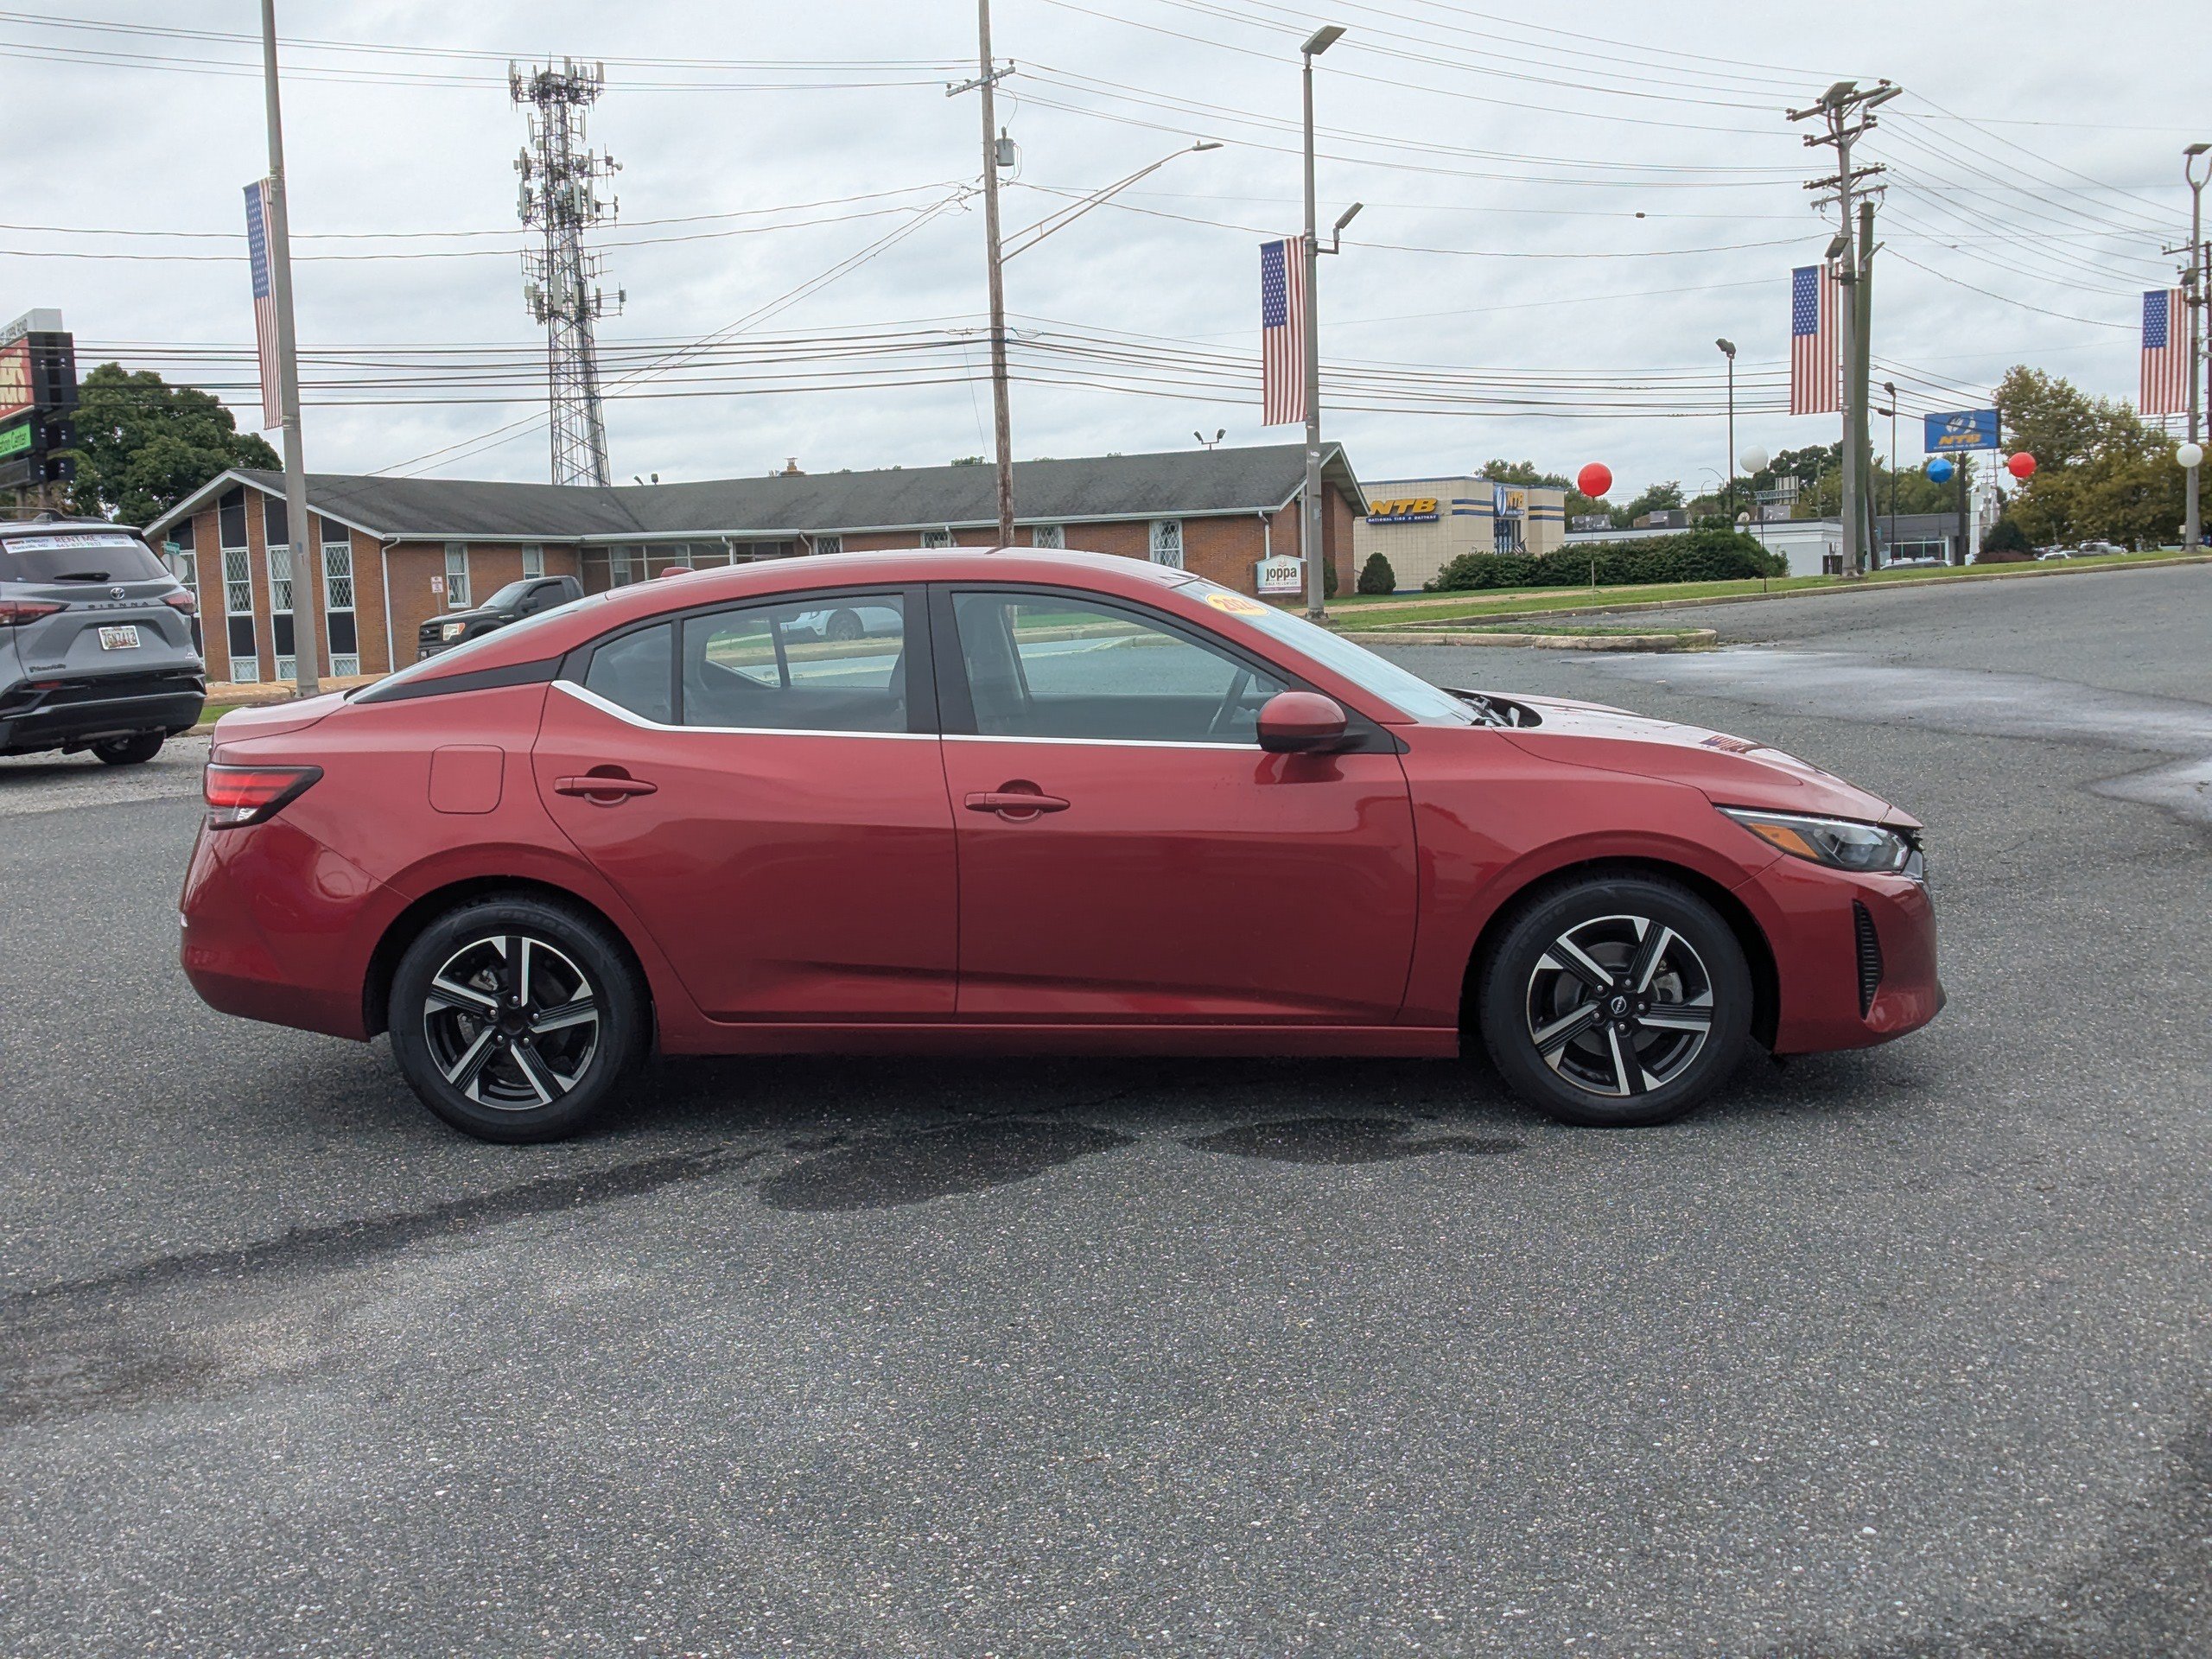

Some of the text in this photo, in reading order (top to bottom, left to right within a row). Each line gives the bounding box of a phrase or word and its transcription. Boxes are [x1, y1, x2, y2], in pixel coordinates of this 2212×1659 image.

[1938, 433, 1982, 446] NTB
[1370, 497, 1438, 516] NTB
[1507, 490, 1524, 508] NTB
